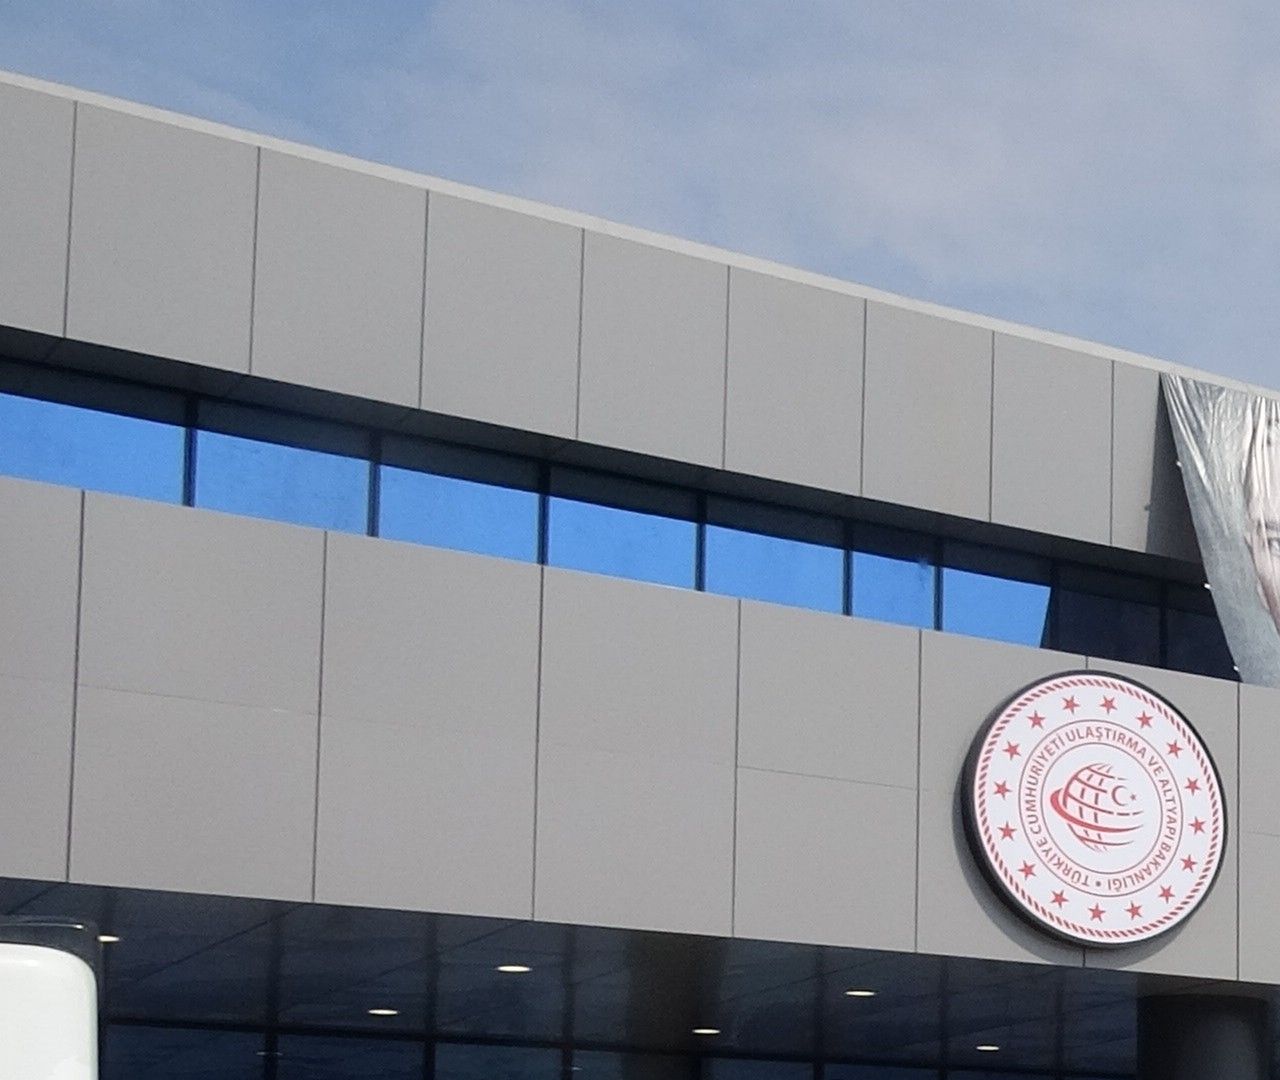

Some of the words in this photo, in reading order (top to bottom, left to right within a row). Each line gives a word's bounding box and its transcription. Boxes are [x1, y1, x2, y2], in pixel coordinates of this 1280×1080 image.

[1065, 725, 1147, 759] ULAŞTIRMA
[1147, 755, 1164, 777] VE
[1159, 778, 1178, 843] ALTYAPI
[1107, 842, 1171, 893] BAKANLIĞI
